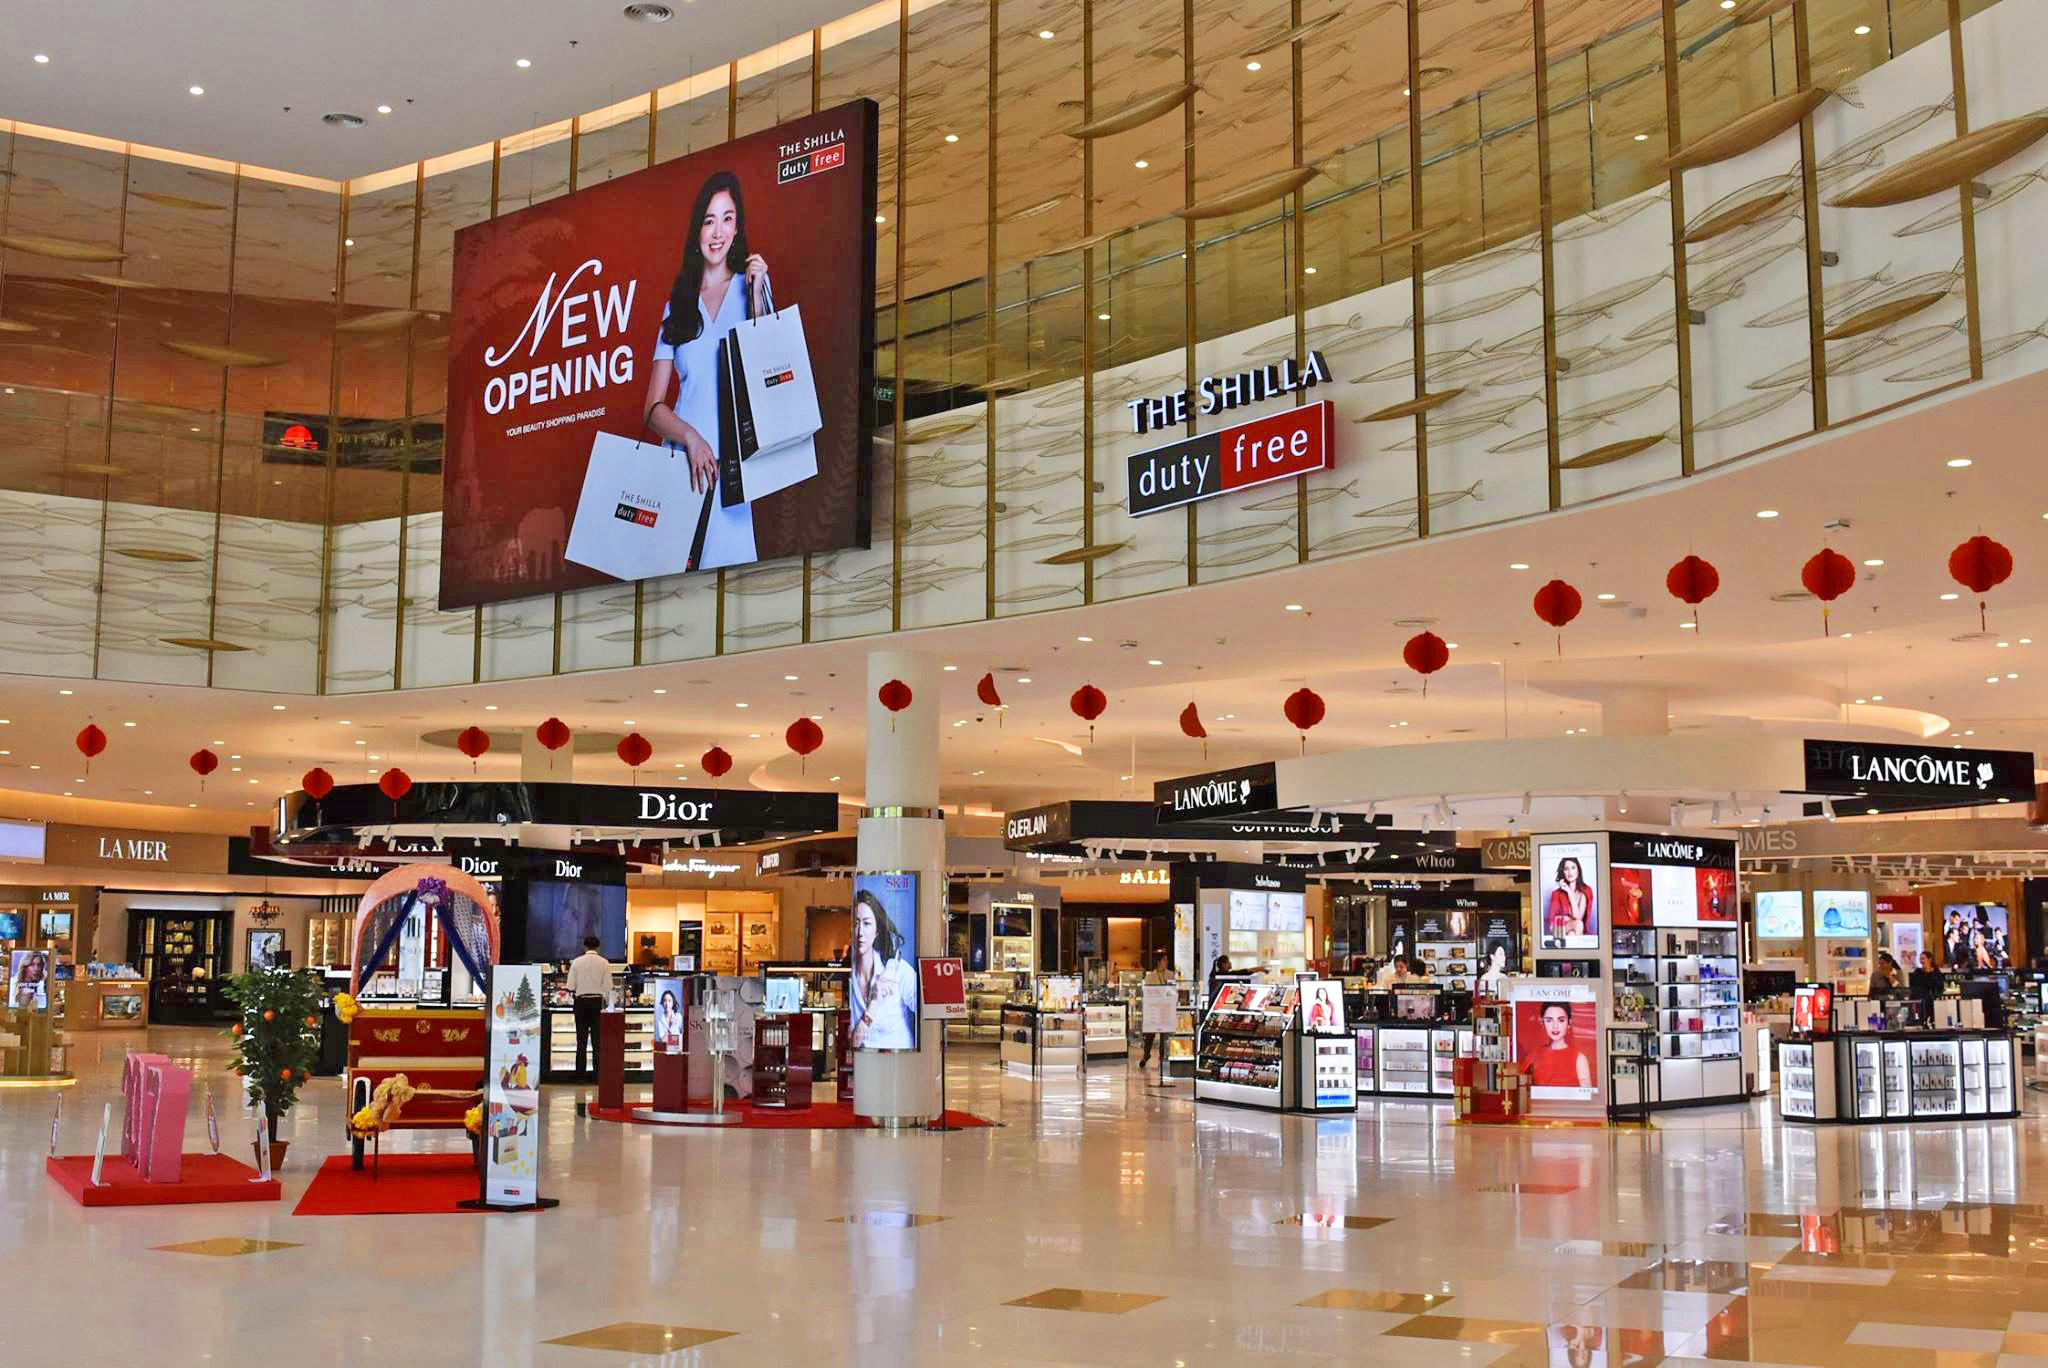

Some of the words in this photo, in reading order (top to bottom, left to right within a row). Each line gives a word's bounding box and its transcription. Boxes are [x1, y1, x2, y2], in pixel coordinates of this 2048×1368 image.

[778, 142, 801, 157] THE
[803, 128, 845, 151] SHILLA
[781, 160, 809, 177] duty
[814, 151, 840, 167] free
[484, 258, 637, 367] NEW
[483, 344, 634, 415] OPENING
[1127, 388, 1190, 433] THE
[1199, 350, 1328, 415] SHILLA
[505, 426, 522, 437] YOUR
[522, 420, 546, 434] BEAUTY
[545, 413, 576, 429] SHOPPING
[576, 406, 606, 421] PARADISE
[1139, 454, 1211, 497] duty
[1233, 427, 1308, 473] free
[620, 490, 634, 503] THE
[635, 494, 661, 510] SHILLA
[617, 506, 637, 521] duty
[637, 511, 656, 524] free
[1851, 754, 1971, 786] LANCÔME
[637, 792, 713, 822] Dior
[1174, 779, 1238, 811] LANCÔME
[1007, 814, 1047, 840] GUERLAIN
[99, 837, 123, 859] LA
[127, 839, 169, 862] MER
[1415, 854, 1456, 869] Whoo
[1647, 841, 1694, 861] LANCÔME
[461, 855, 499, 875] Dior
[555, 859, 583, 879] Dior
[42, 892, 53, 901] LA
[53, 892, 70, 901] MER
[934, 962, 961, 977] 10%
[945, 1005, 965, 1015] Sale
